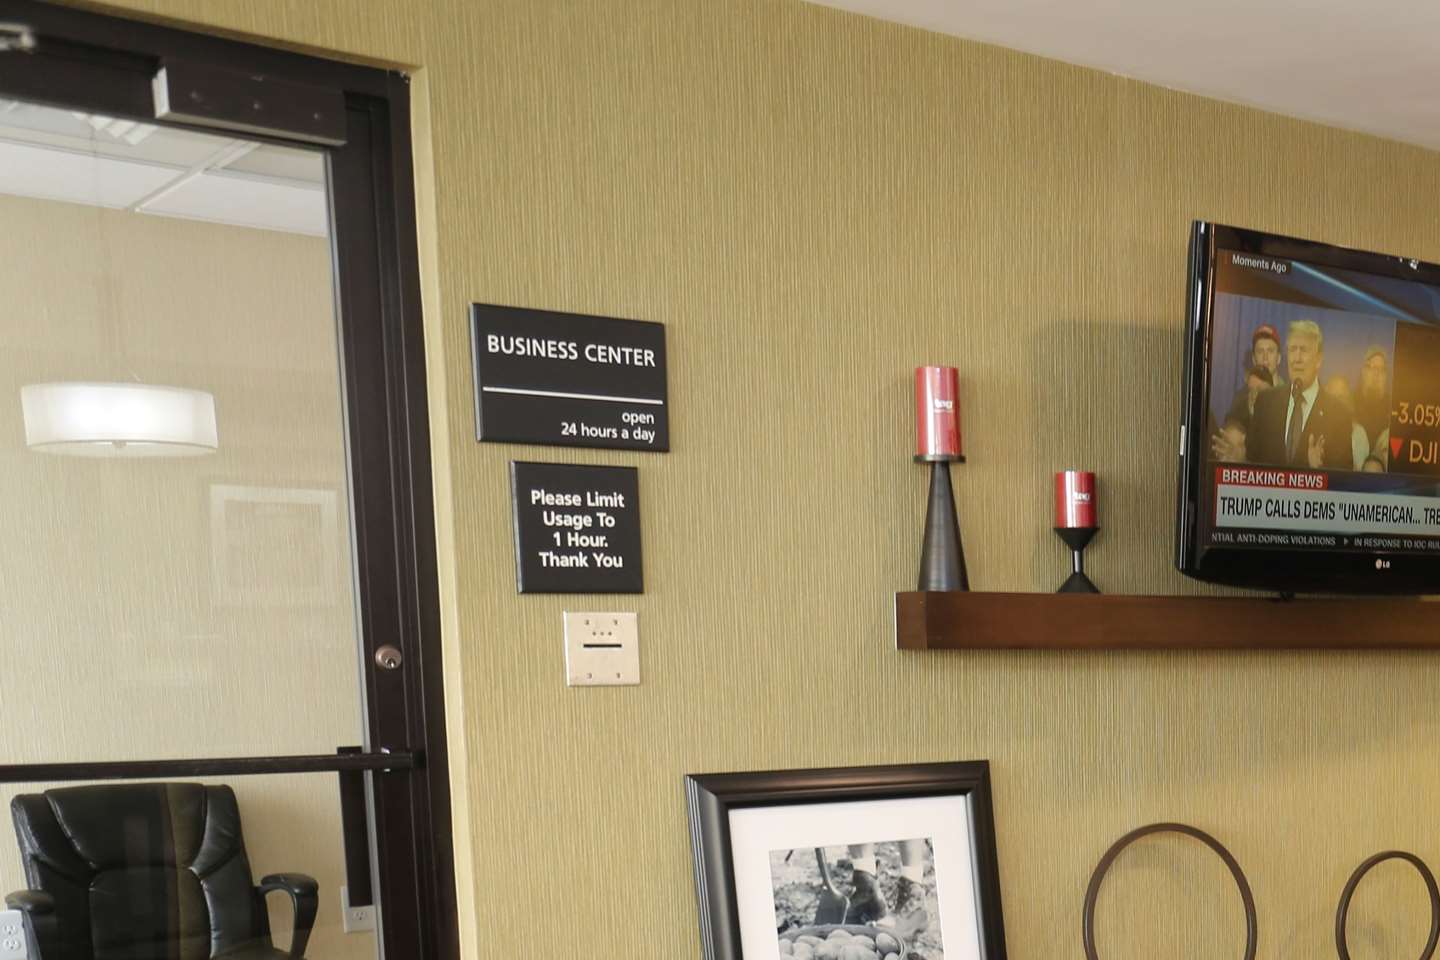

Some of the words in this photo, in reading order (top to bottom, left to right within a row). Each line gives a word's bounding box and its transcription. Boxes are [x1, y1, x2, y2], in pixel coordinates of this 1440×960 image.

[1232, 254, 1269, 270] Moments
[1271, 261, 1287, 274] Ago
[487, 334, 578, 360] BUSINESS
[585, 344, 656, 367] CENTER
[622, 411, 655, 425] open
[561, 422, 577, 436] 24
[581, 423, 618, 439] hours
[621, 427, 629, 439] a
[633, 427, 656, 443] day
[1409, 440, 1439, 464] DJI
[1222, 469, 1285, 486] BREAKING
[1289, 473, 1324, 488] NEWS
[531, 488, 582, 507] Please
[586, 491, 625, 508] Limit
[543, 510, 593, 530] Usage
[596, 512, 616, 527] To
[1221, 496, 1263, 517] TRUMP
[1266, 499, 1301, 518] CALLS
[1304, 501, 1336, 521] DEMS
[1339, 502, 1420, 524] "UNAMERICAN...
[553, 531, 561, 546] 1
[567, 531, 608, 547] Hour.
[1291, 536, 1336, 546] VIOLATIONS
[1363, 538, 1400, 549] RESPONSE
[1403, 540, 1412, 549] TO
[538, 551, 589, 567] Thank
[593, 552, 623, 568] You
